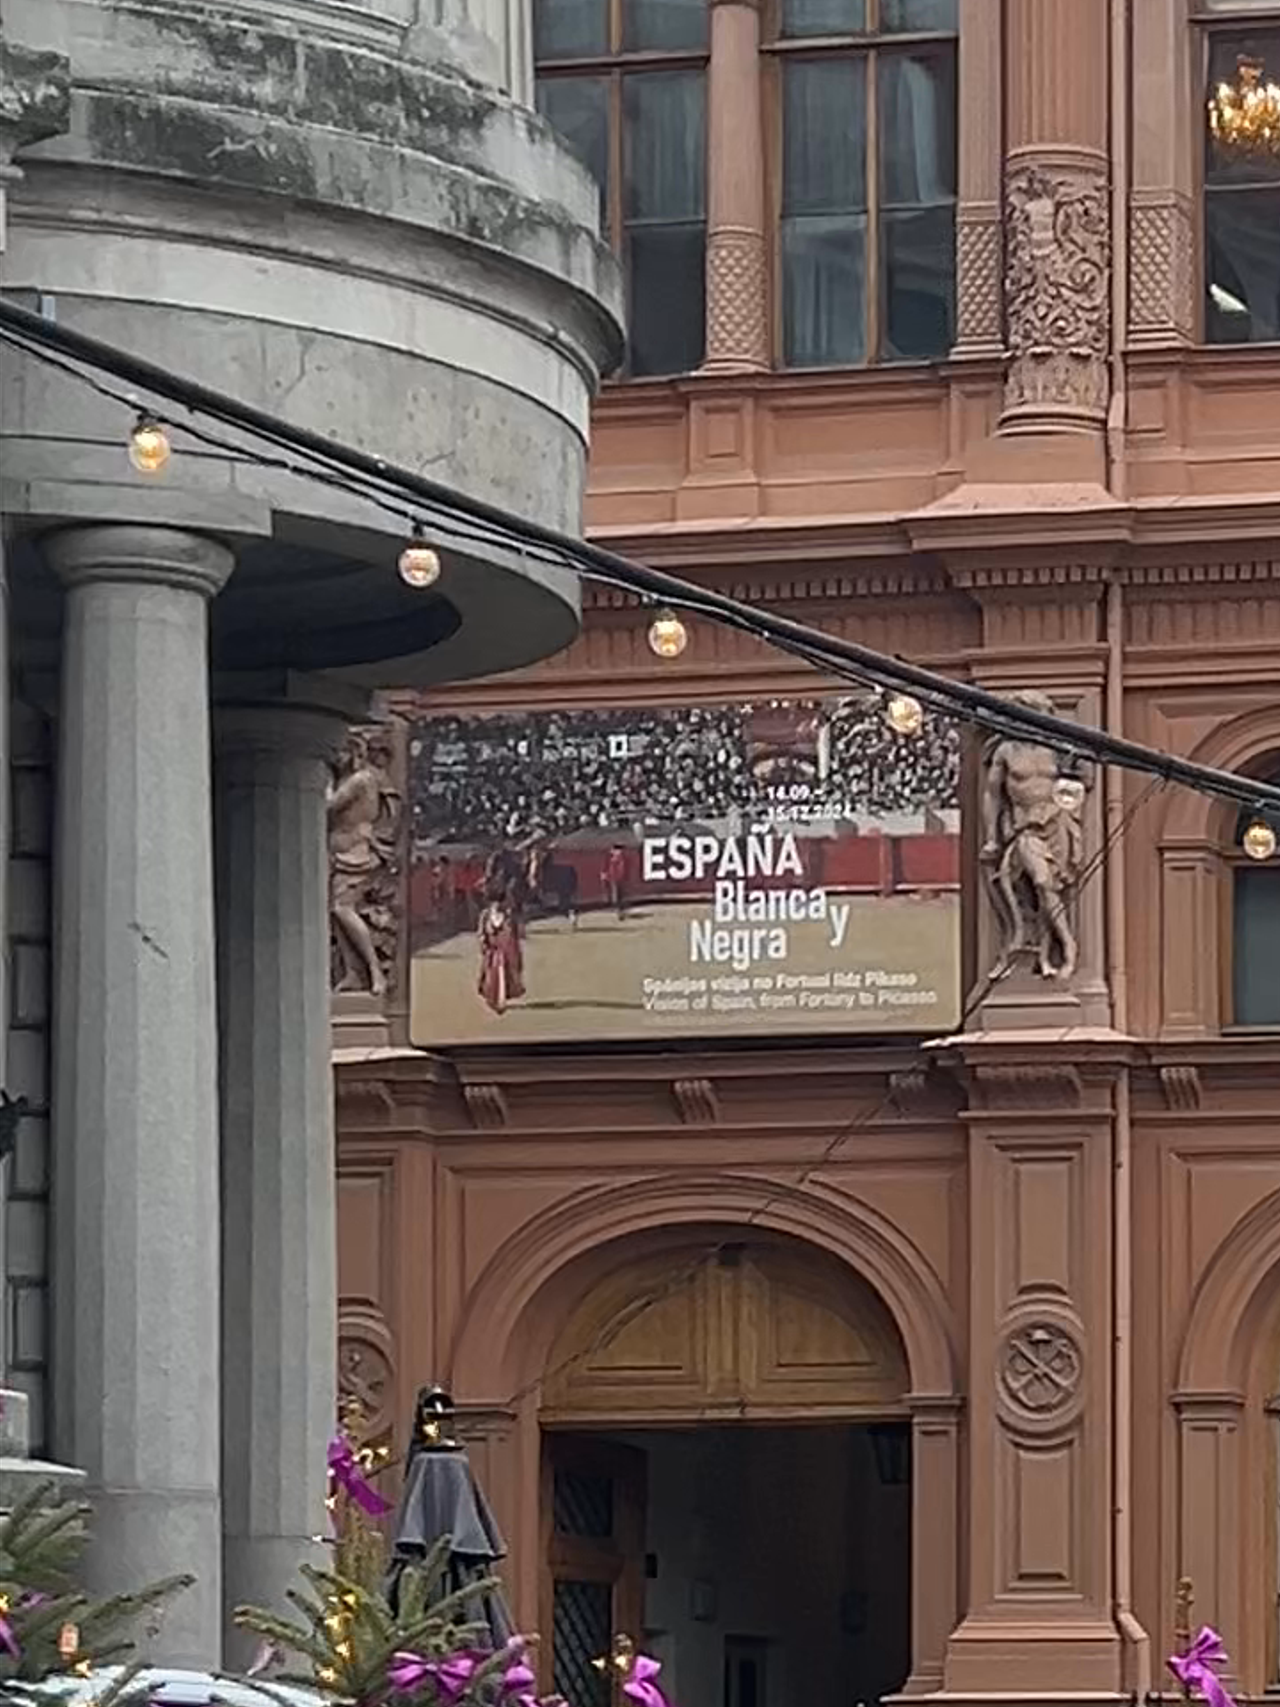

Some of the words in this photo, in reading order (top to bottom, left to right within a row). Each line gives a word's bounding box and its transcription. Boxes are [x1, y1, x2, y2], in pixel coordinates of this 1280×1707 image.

[643, 823, 803, 881] ESPAÑA
[715, 880, 827, 923] Blanca
[829, 904, 850, 947] y
[690, 919, 787, 971] Negra
[691, 993, 709, 1011] of
[859, 991, 875, 1005] to
